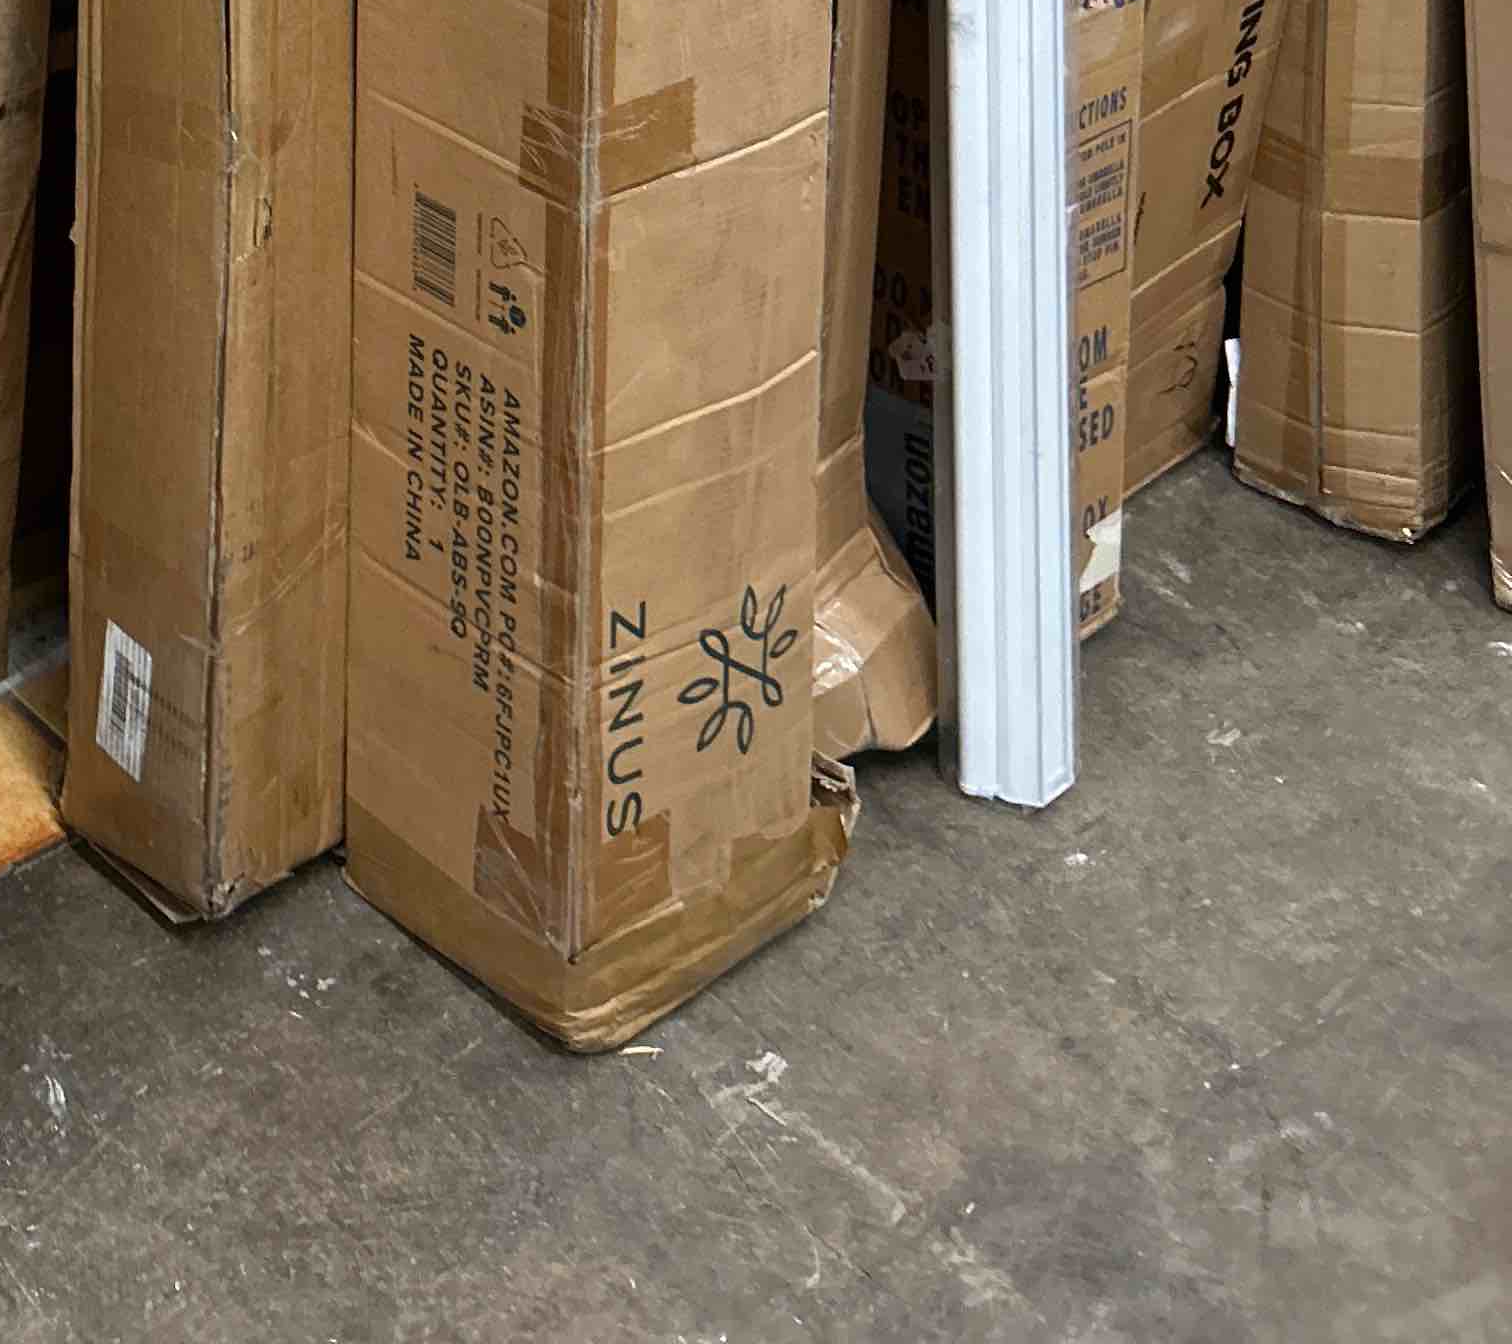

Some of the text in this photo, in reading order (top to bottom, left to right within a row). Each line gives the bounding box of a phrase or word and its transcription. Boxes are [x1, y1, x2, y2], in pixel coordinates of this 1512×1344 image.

[1201, 92, 1245, 209] BOX
[404, 333, 426, 562] MADE IN CHINA
[428, 347, 449, 553] QUANTITY: 1
[453, 360, 472, 452] SKU#:
[476, 373, 496, 477] ASIN#:
[498, 387, 520, 602] AMAZON.COM
[607, 600, 647, 837] ZINUS
